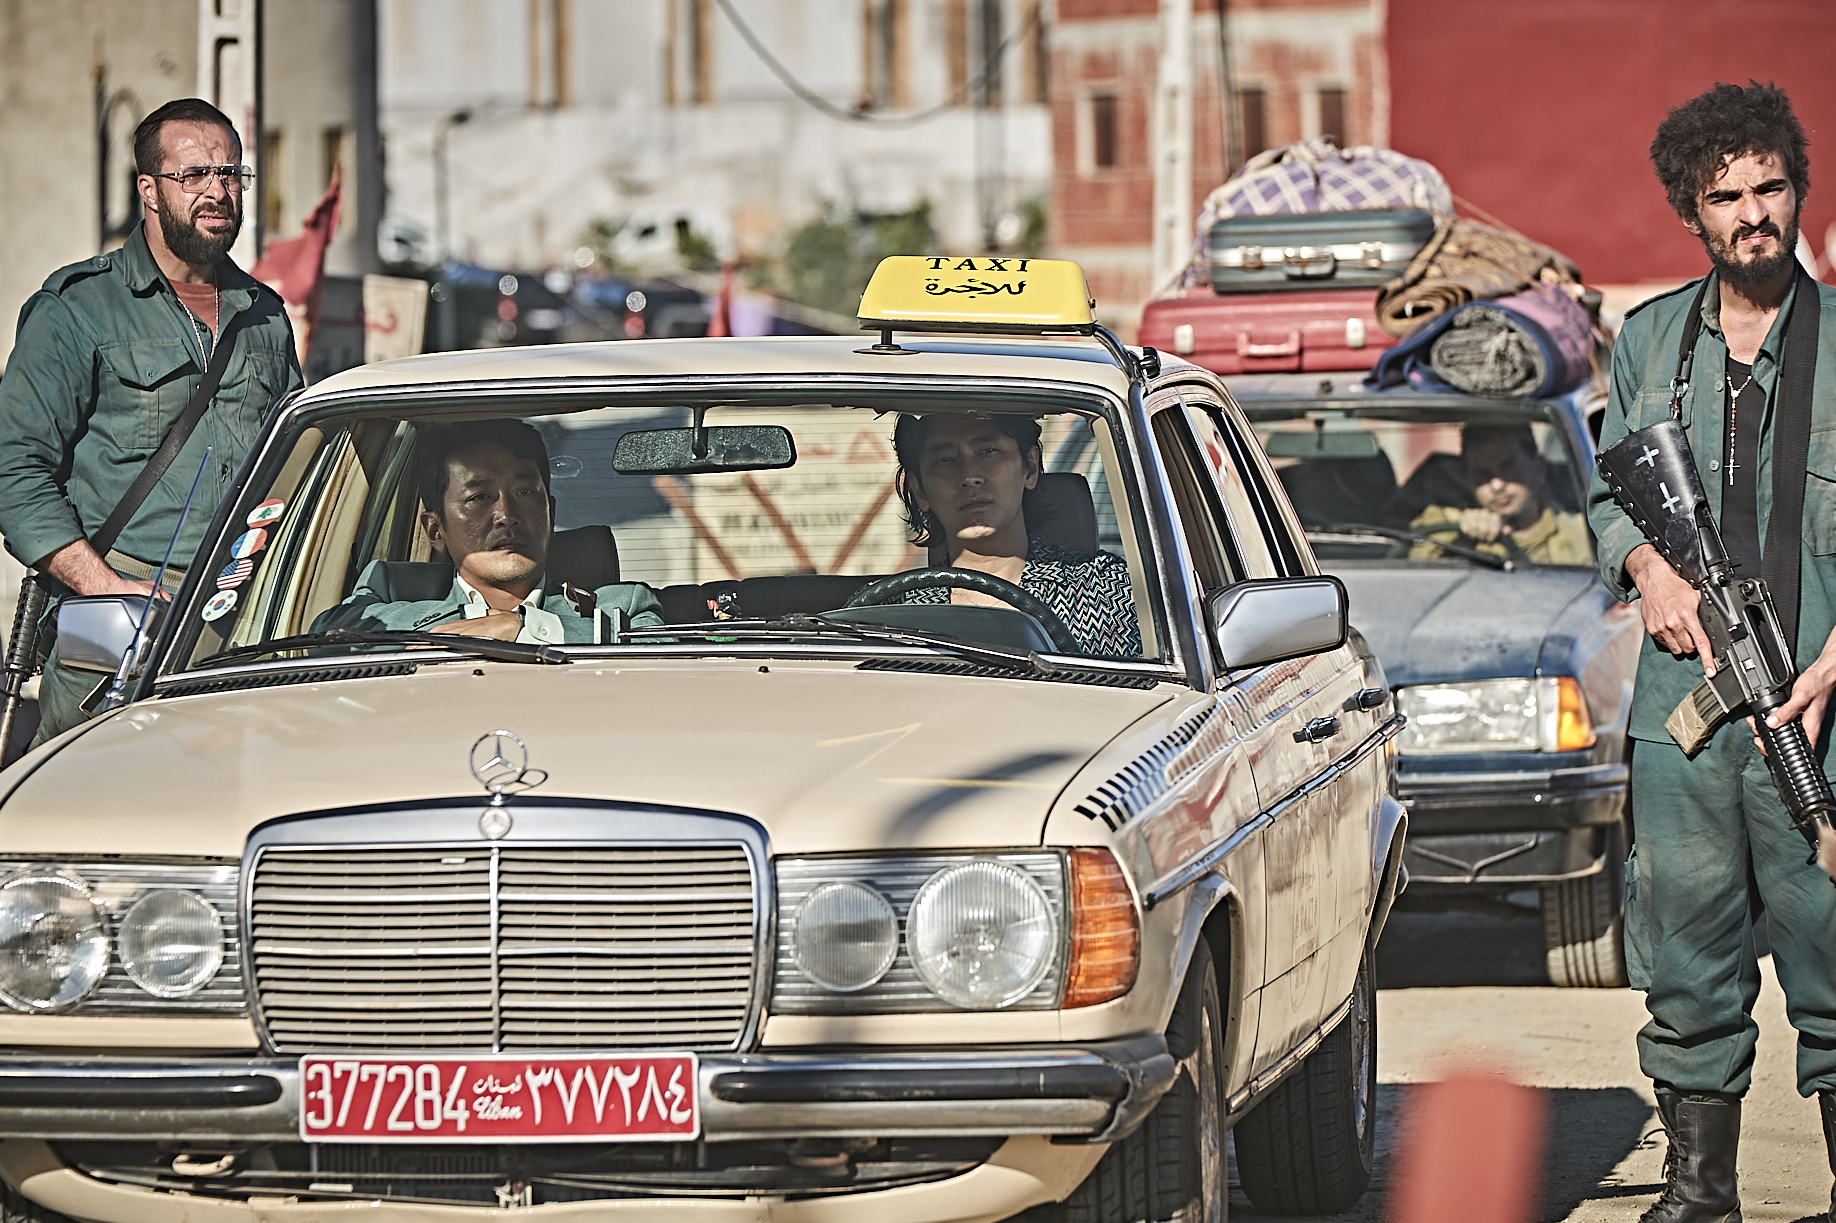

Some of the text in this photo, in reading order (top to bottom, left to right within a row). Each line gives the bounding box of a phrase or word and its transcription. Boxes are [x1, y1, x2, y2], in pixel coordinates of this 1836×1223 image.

[925, 257, 1030, 272] TAXI
[306, 1061, 470, 1132] 377284
[472, 1073, 523, 1095] لبنان
[525, 1064, 692, 1127] ٣٧٧٢٨٤
[472, 1094, 523, 1121] Liban
